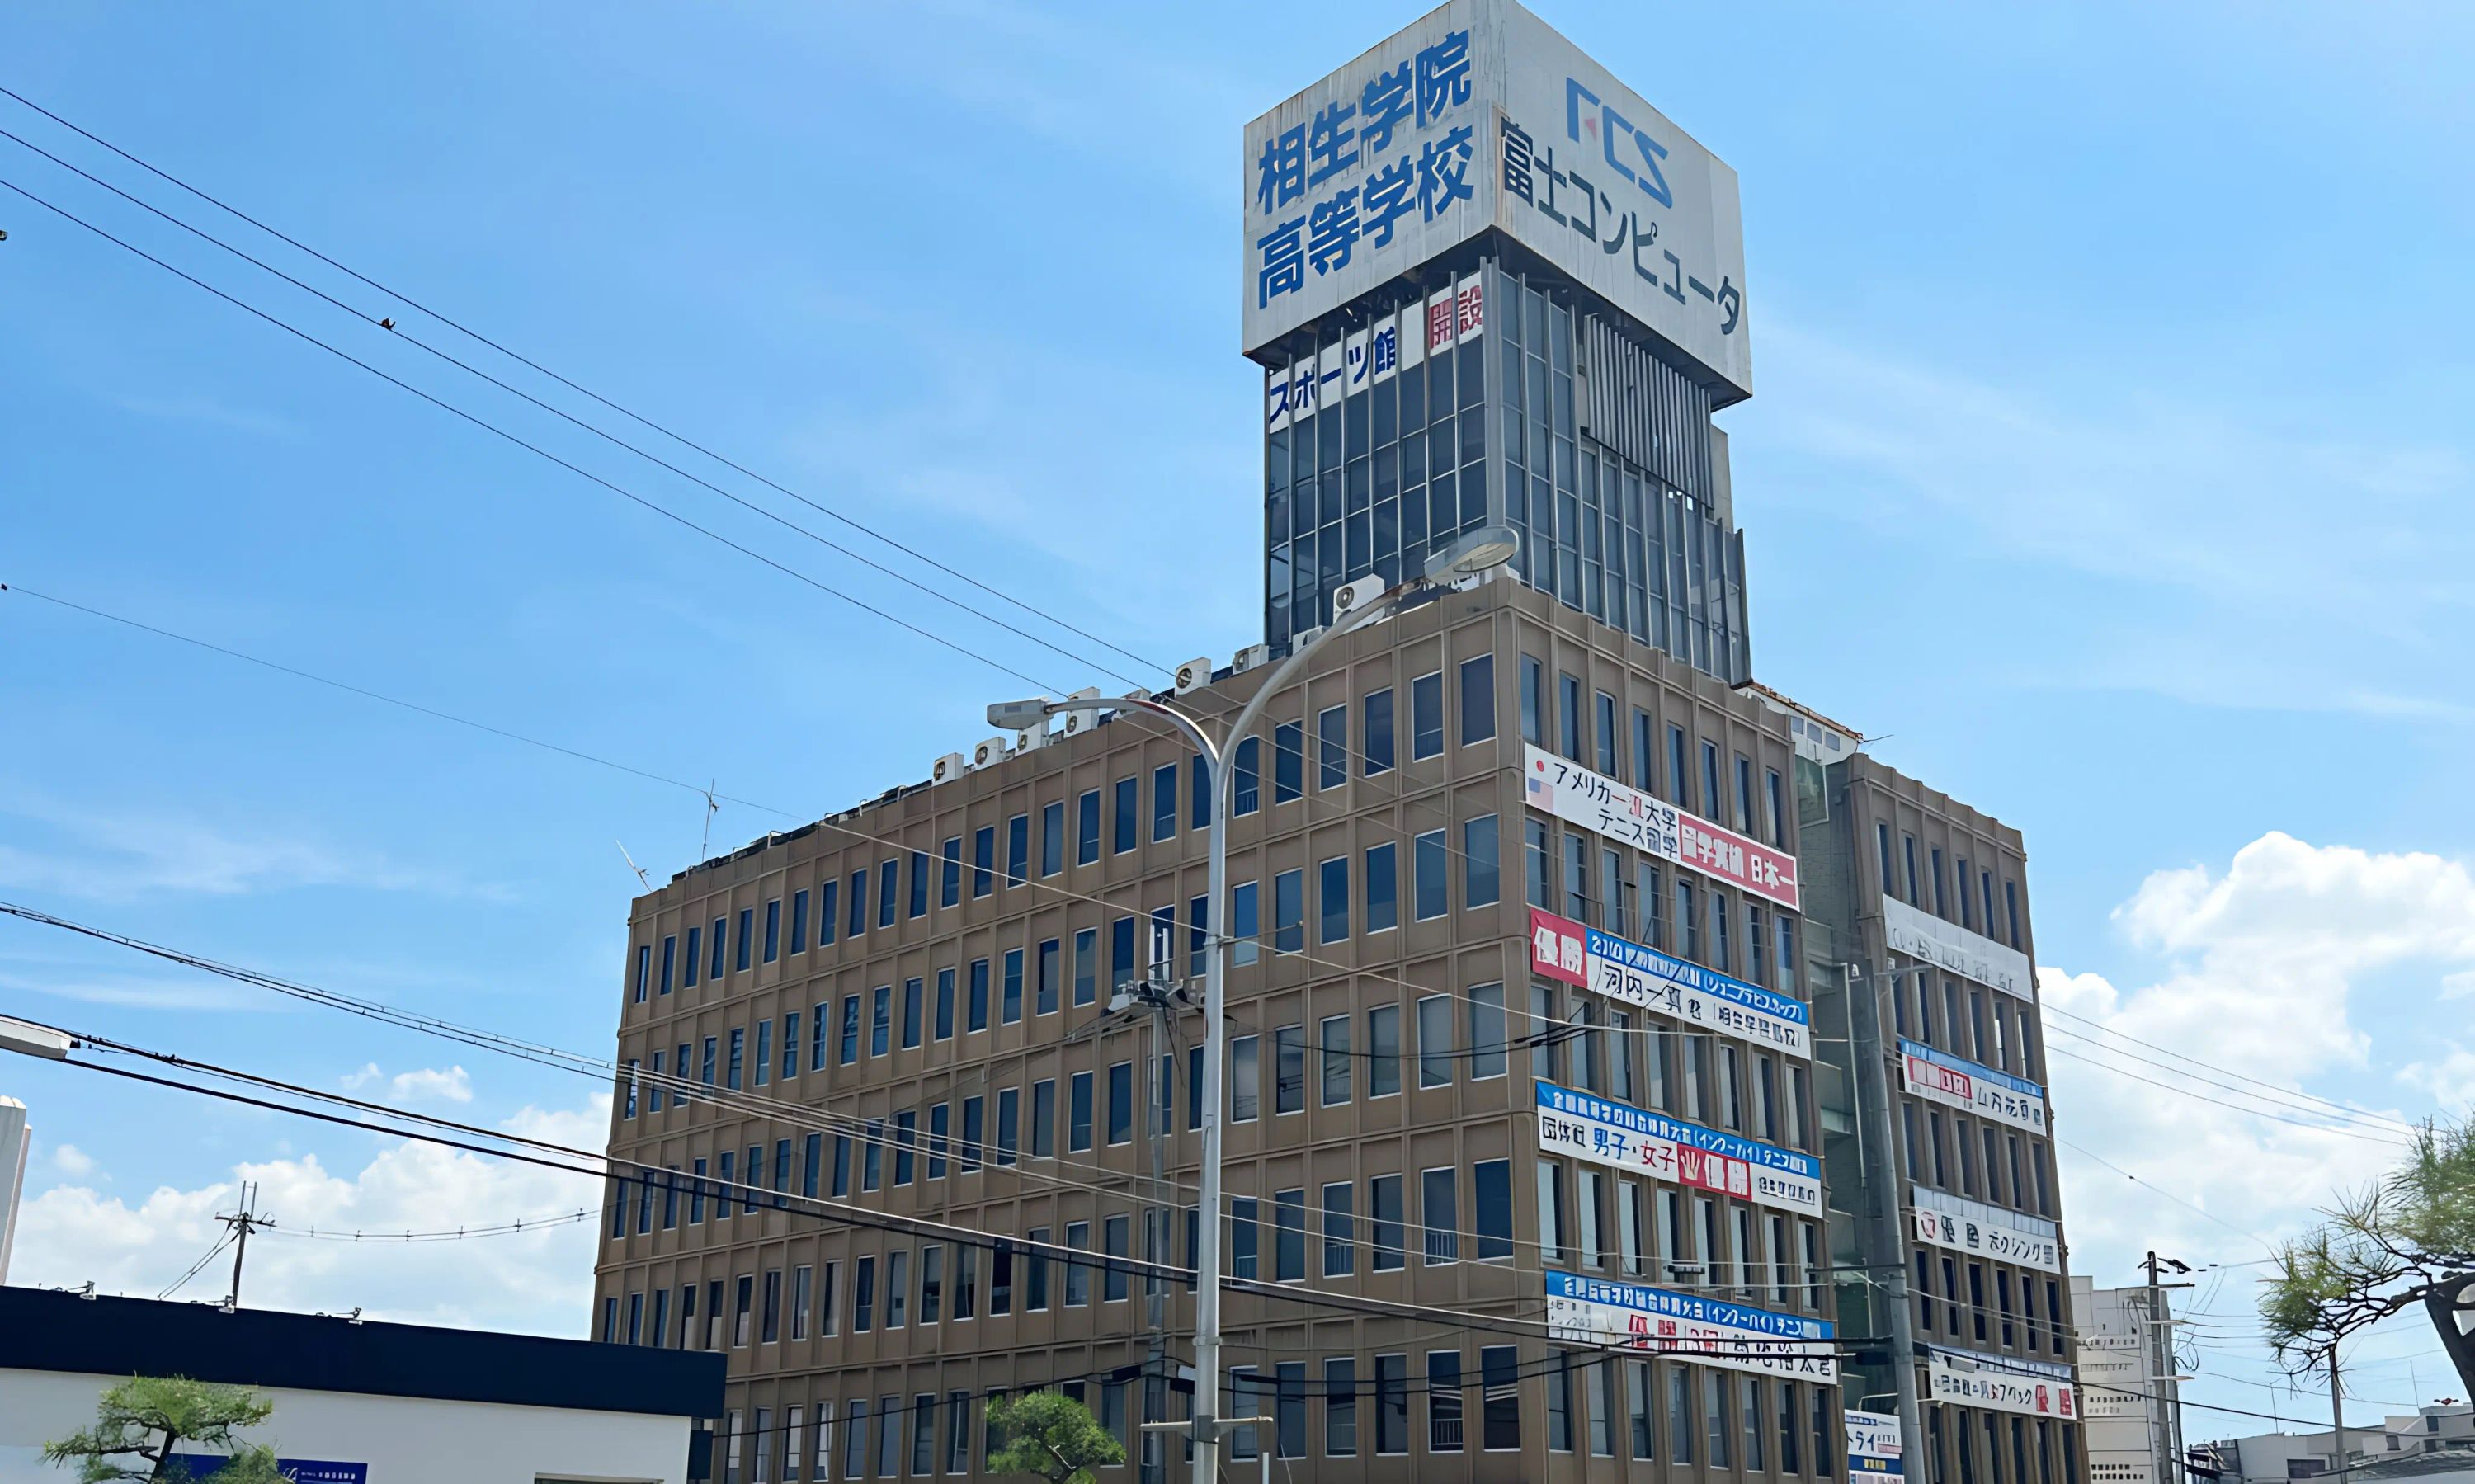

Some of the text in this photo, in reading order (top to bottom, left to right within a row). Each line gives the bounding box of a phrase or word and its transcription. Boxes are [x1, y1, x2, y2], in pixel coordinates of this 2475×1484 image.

[1258, 29, 1471, 214] 相生学院
[1257, 125, 1473, 309] 高等学校
[1501, 116, 1740, 335] 富士コンピュータ
